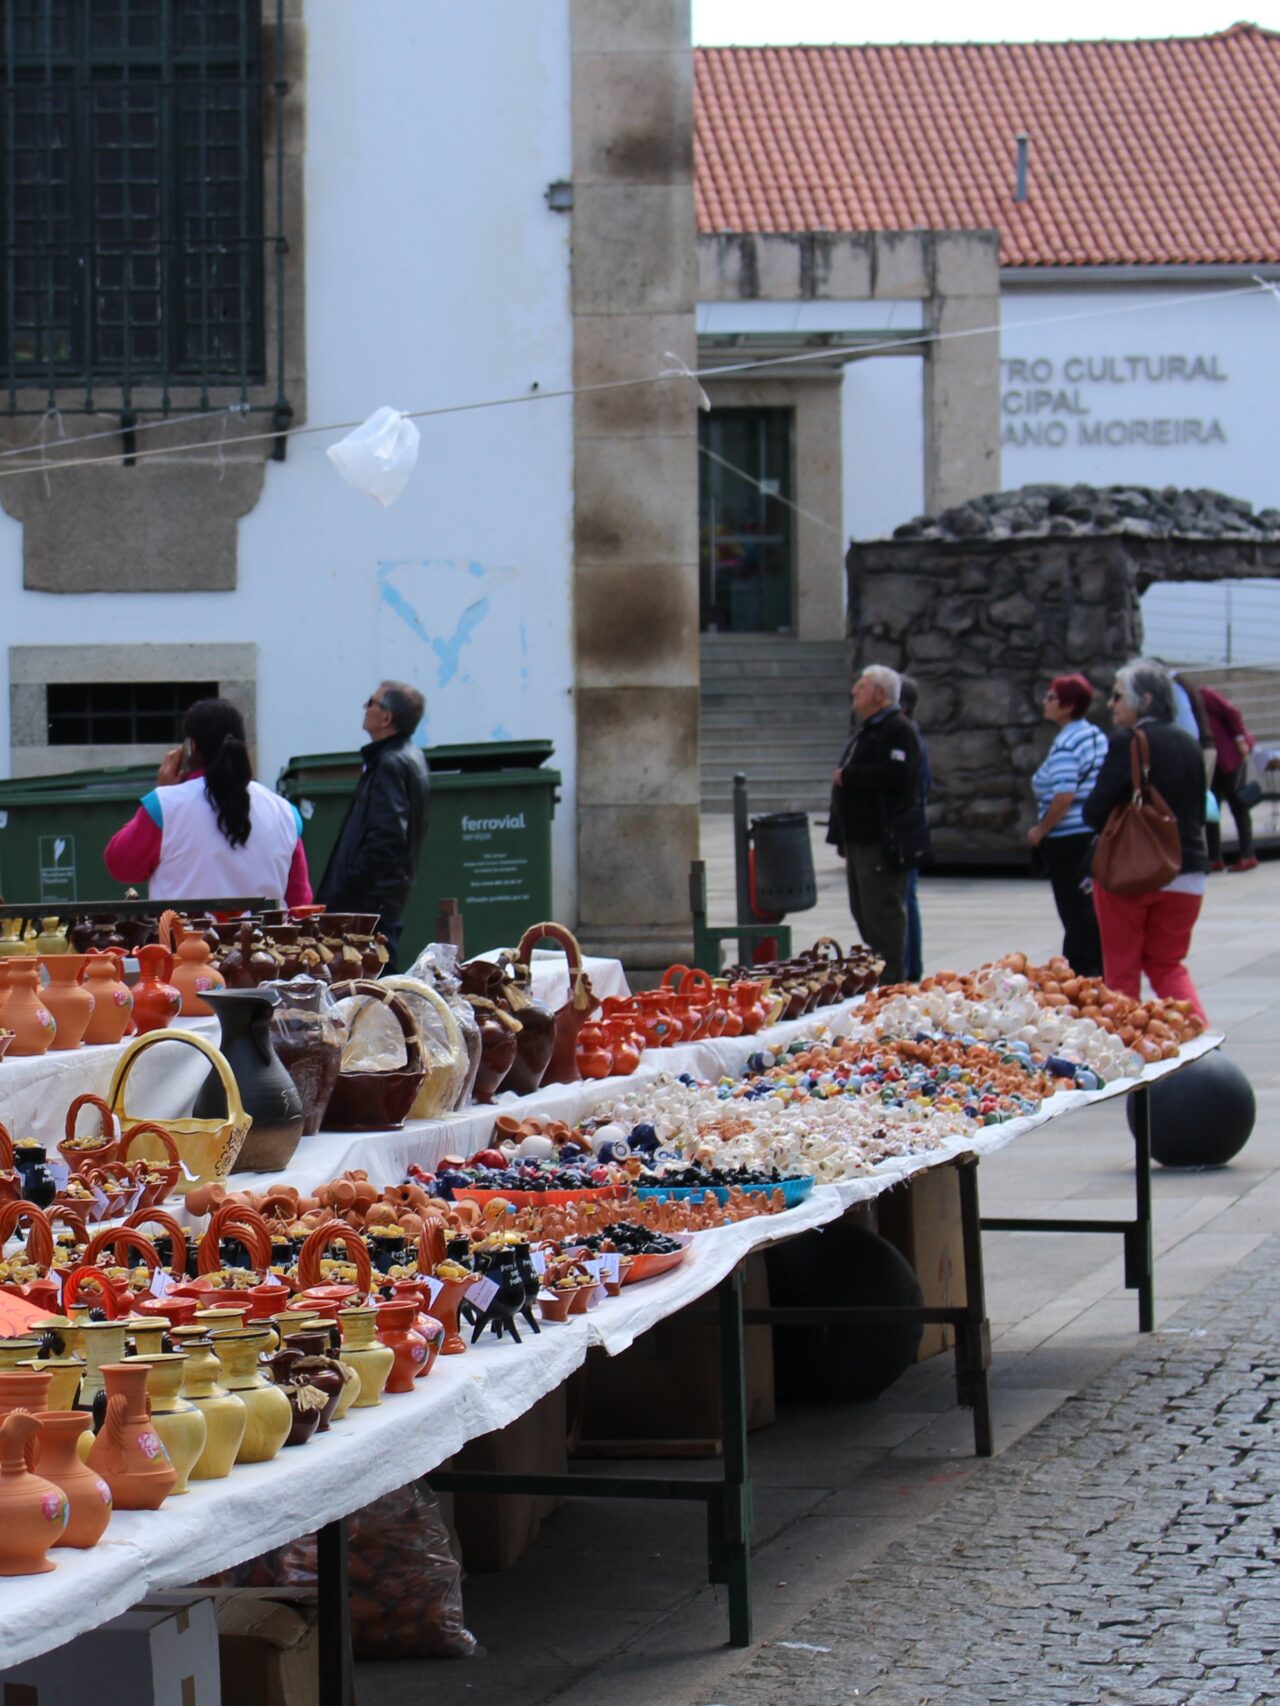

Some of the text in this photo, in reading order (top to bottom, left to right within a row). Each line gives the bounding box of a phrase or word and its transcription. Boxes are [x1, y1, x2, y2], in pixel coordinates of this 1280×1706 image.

[999, 353, 1228, 383] RO CULTURAL
[1002, 389, 1090, 415] CIPAL
[1078, 418, 1227, 446] MOREIRA
[461, 813, 526, 831] ferrovial
